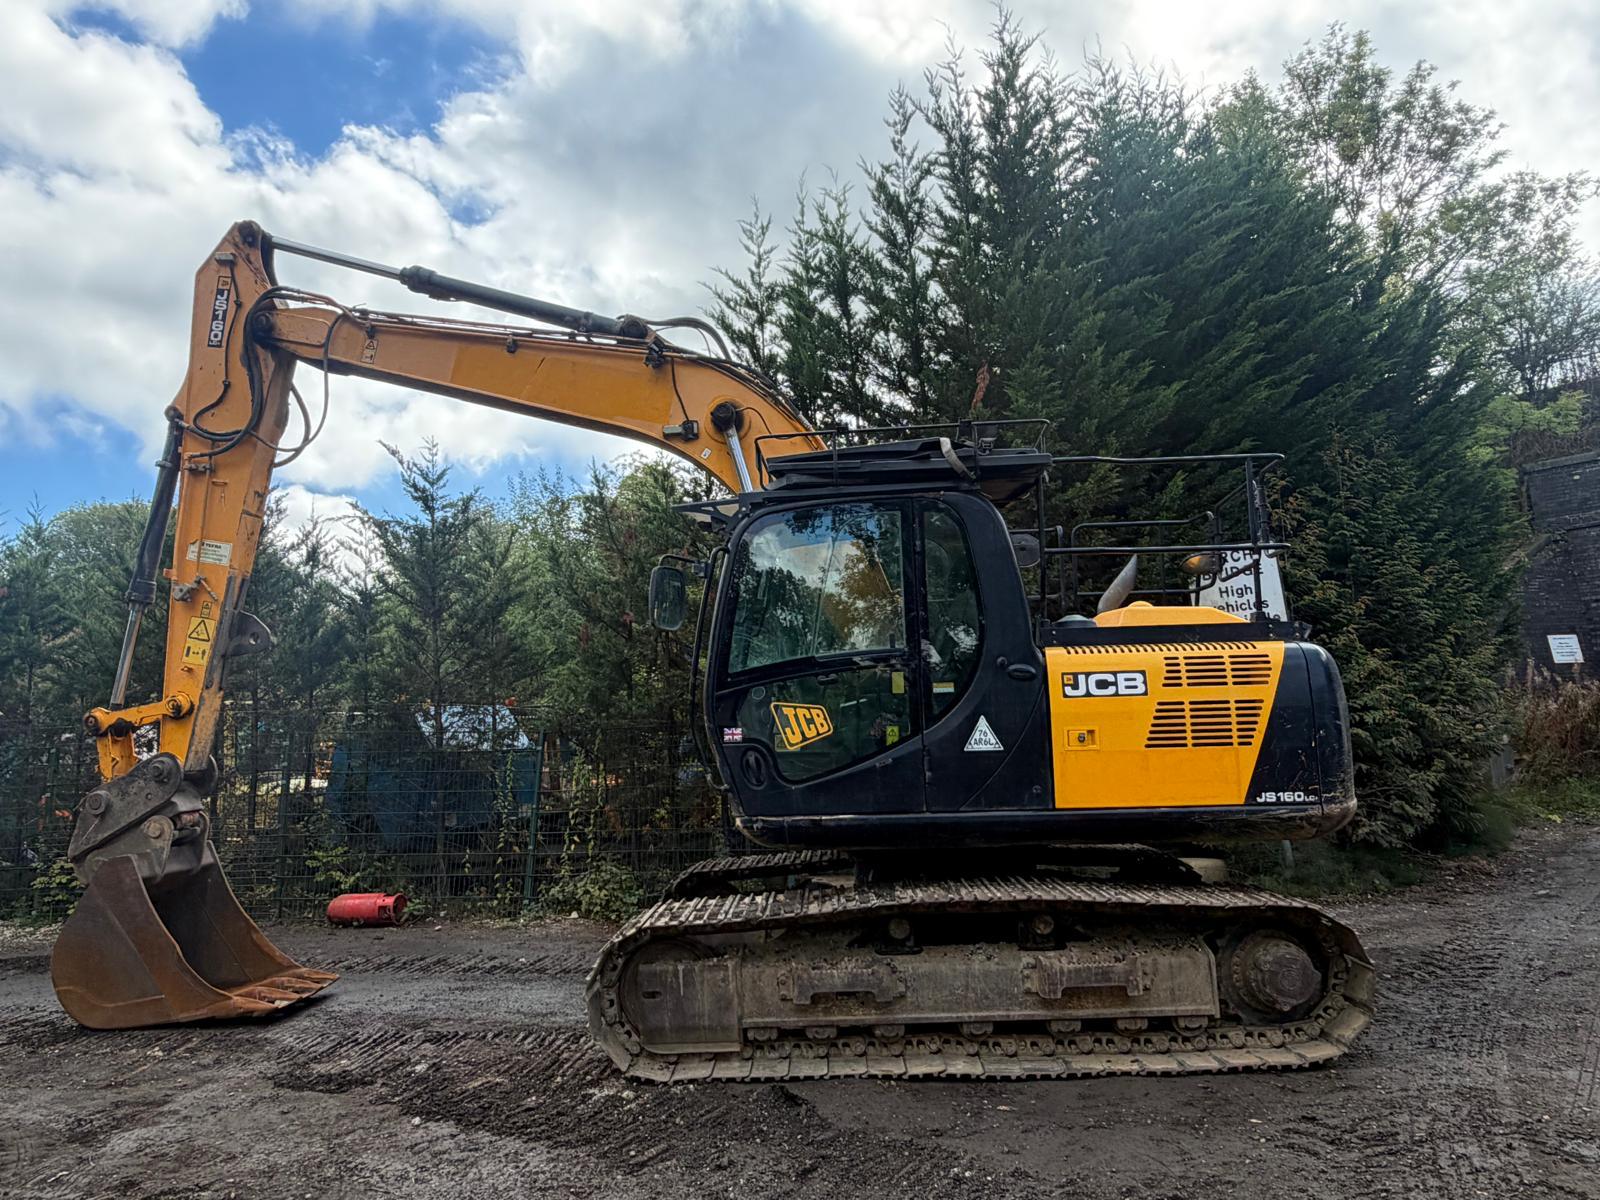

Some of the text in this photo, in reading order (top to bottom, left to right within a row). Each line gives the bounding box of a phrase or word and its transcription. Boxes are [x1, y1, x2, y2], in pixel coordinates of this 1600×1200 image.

[210, 290, 228, 341] JS160
[1219, 549, 1253, 563] RCH
[1203, 563, 1264, 580] BIDG
[1219, 584, 1253, 598] High
[1213, 599, 1270, 613] ehicls
[1064, 672, 1146, 697] JCB
[782, 706, 829, 744] JCB
[1256, 791, 1304, 802] JS160
